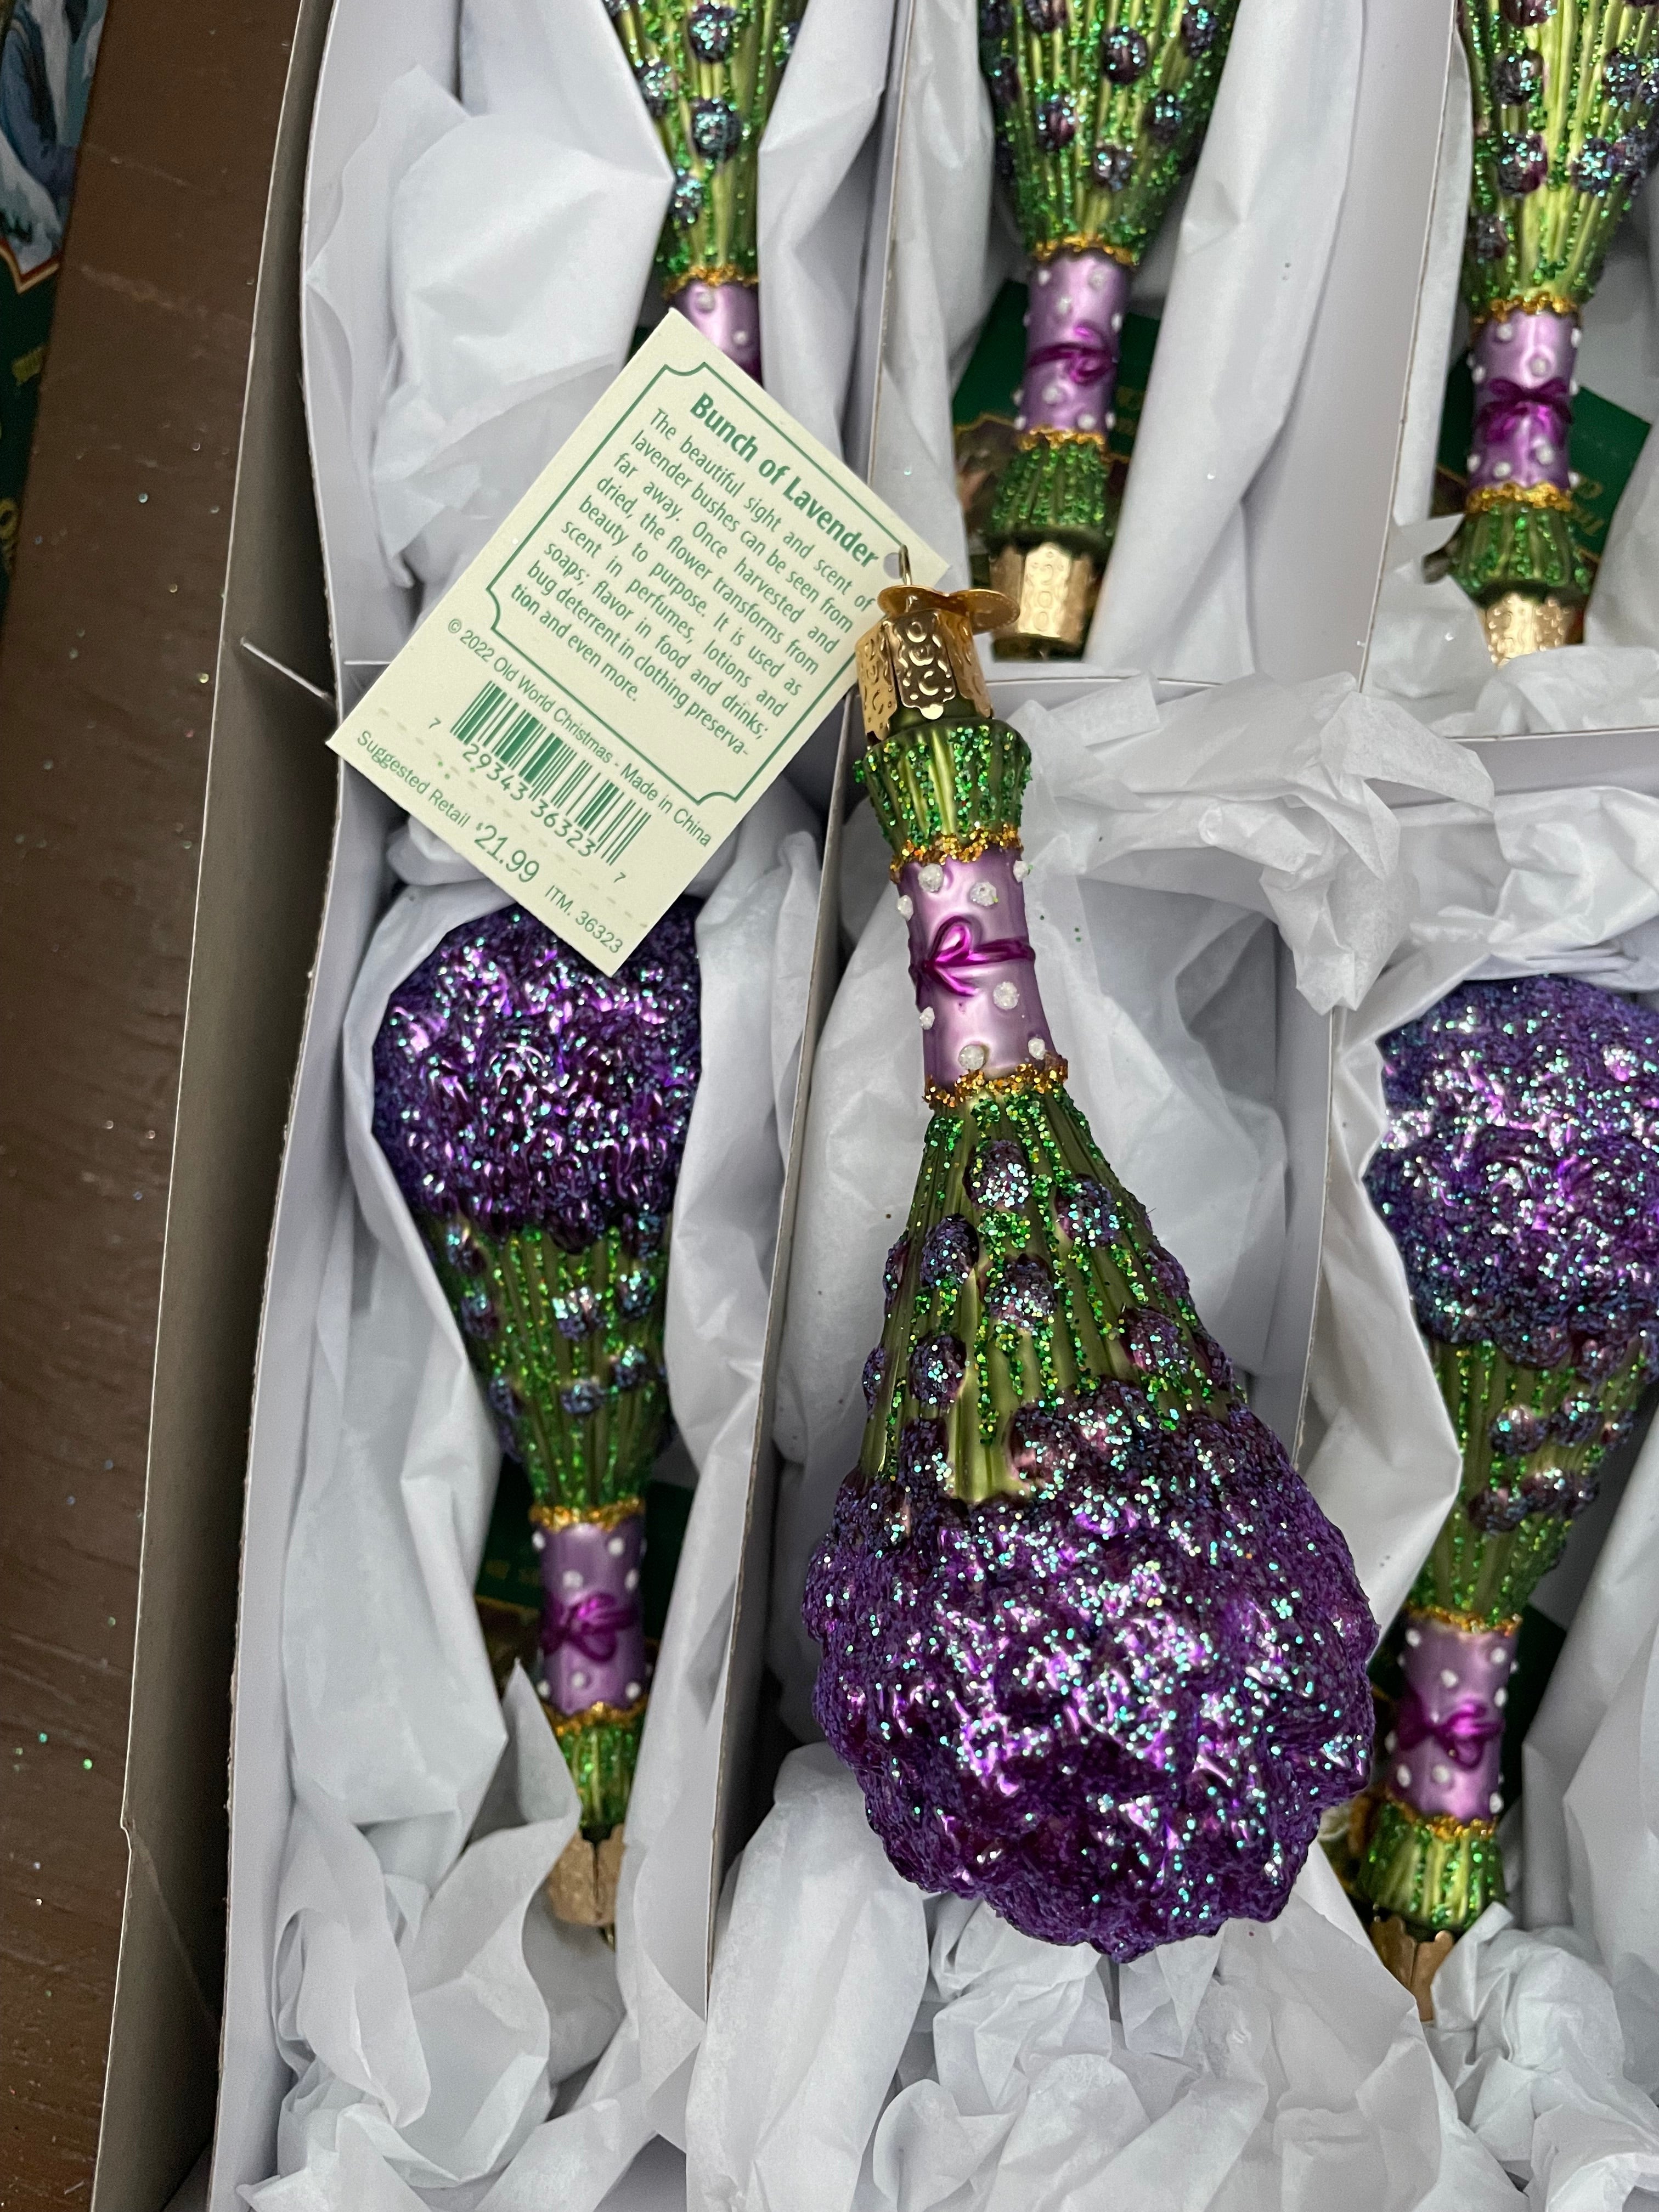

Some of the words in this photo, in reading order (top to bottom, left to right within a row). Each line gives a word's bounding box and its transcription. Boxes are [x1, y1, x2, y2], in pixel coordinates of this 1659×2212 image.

[596, 476, 639, 520] dried,
[639, 512, 666, 542] the
[665, 534, 714, 580] flower
[712, 575, 785, 645] transforms
[784, 638, 820, 676] from
[613, 452, 639, 479] far
[642, 481, 684, 522] away.
[691, 521, 729, 560] Once
[732, 556, 806, 624] harvested
[806, 625, 840, 655] and
[630, 428, 694, 490] lavender
[690, 481, 741, 533] bushes
[740, 529, 767, 557] can
[765, 548, 787, 575] be
[785, 570, 820, 604] seen
[819, 596, 854, 634] from
[650, 407, 677, 441] The
[678, 434, 746, 499] beautiful
[742, 496, 782, 533] sight
[782, 531, 816, 561] and
[812, 558, 854, 596] scent
[853, 594, 876, 613] of
[689, 391, 759, 464] Bunch
[758, 458, 792, 487] of
[781, 475, 880, 568] Lavender
[510, 583, 541, 617] tion
[539, 609, 573, 640] and
[567, 634, 602, 669] even
[599, 662, 639, 702] more.
[526, 558, 558, 597] bug
[555, 587, 622, 648] deterrent
[617, 637, 635, 661] in
[633, 655, 691, 710] clothing
[683, 700, 749, 755] preserva-
[543, 542, 591, 587] soaps;
[591, 579, 635, 622] flavor
[634, 616, 652, 640] in
[654, 634, 692, 670] food
[689, 668, 723, 697] and
[721, 694, 769, 741] drinks;
[560, 521, 603, 560] scent
[605, 554, 624, 578] in
[624, 577, 696, 645] perfumes,
[702, 639, 753, 689] lotions
[755, 689, 789, 718] and
[578, 494, 630, 546] beauty
[630, 541, 649, 563] to
[647, 561, 708, 618] purpose.
[712, 611, 730, 633] It
[729, 627, 746, 647] is
[747, 645, 786, 679] used
[783, 677, 803, 697] as
[428, 716, 442, 730] 7
[461, 742, 529, 802] 29343
[529, 798, 597, 857] 36323
[612, 871, 627, 884] 7
[459, 629, 495, 663] 2022
[493, 656, 521, 682] Old
[516, 674, 557, 714] World
[552, 707, 614, 764] Christmas
[619, 761, 659, 802] Made
[657, 793, 674, 815] in
[673, 807, 712, 848] China
[356, 729, 431, 795] Suggested
[427, 788, 472, 828] Retail
[473, 821, 540, 883] $21.99
[544, 884, 574, 917] ITM.
[574, 910, 624, 954] 36323
